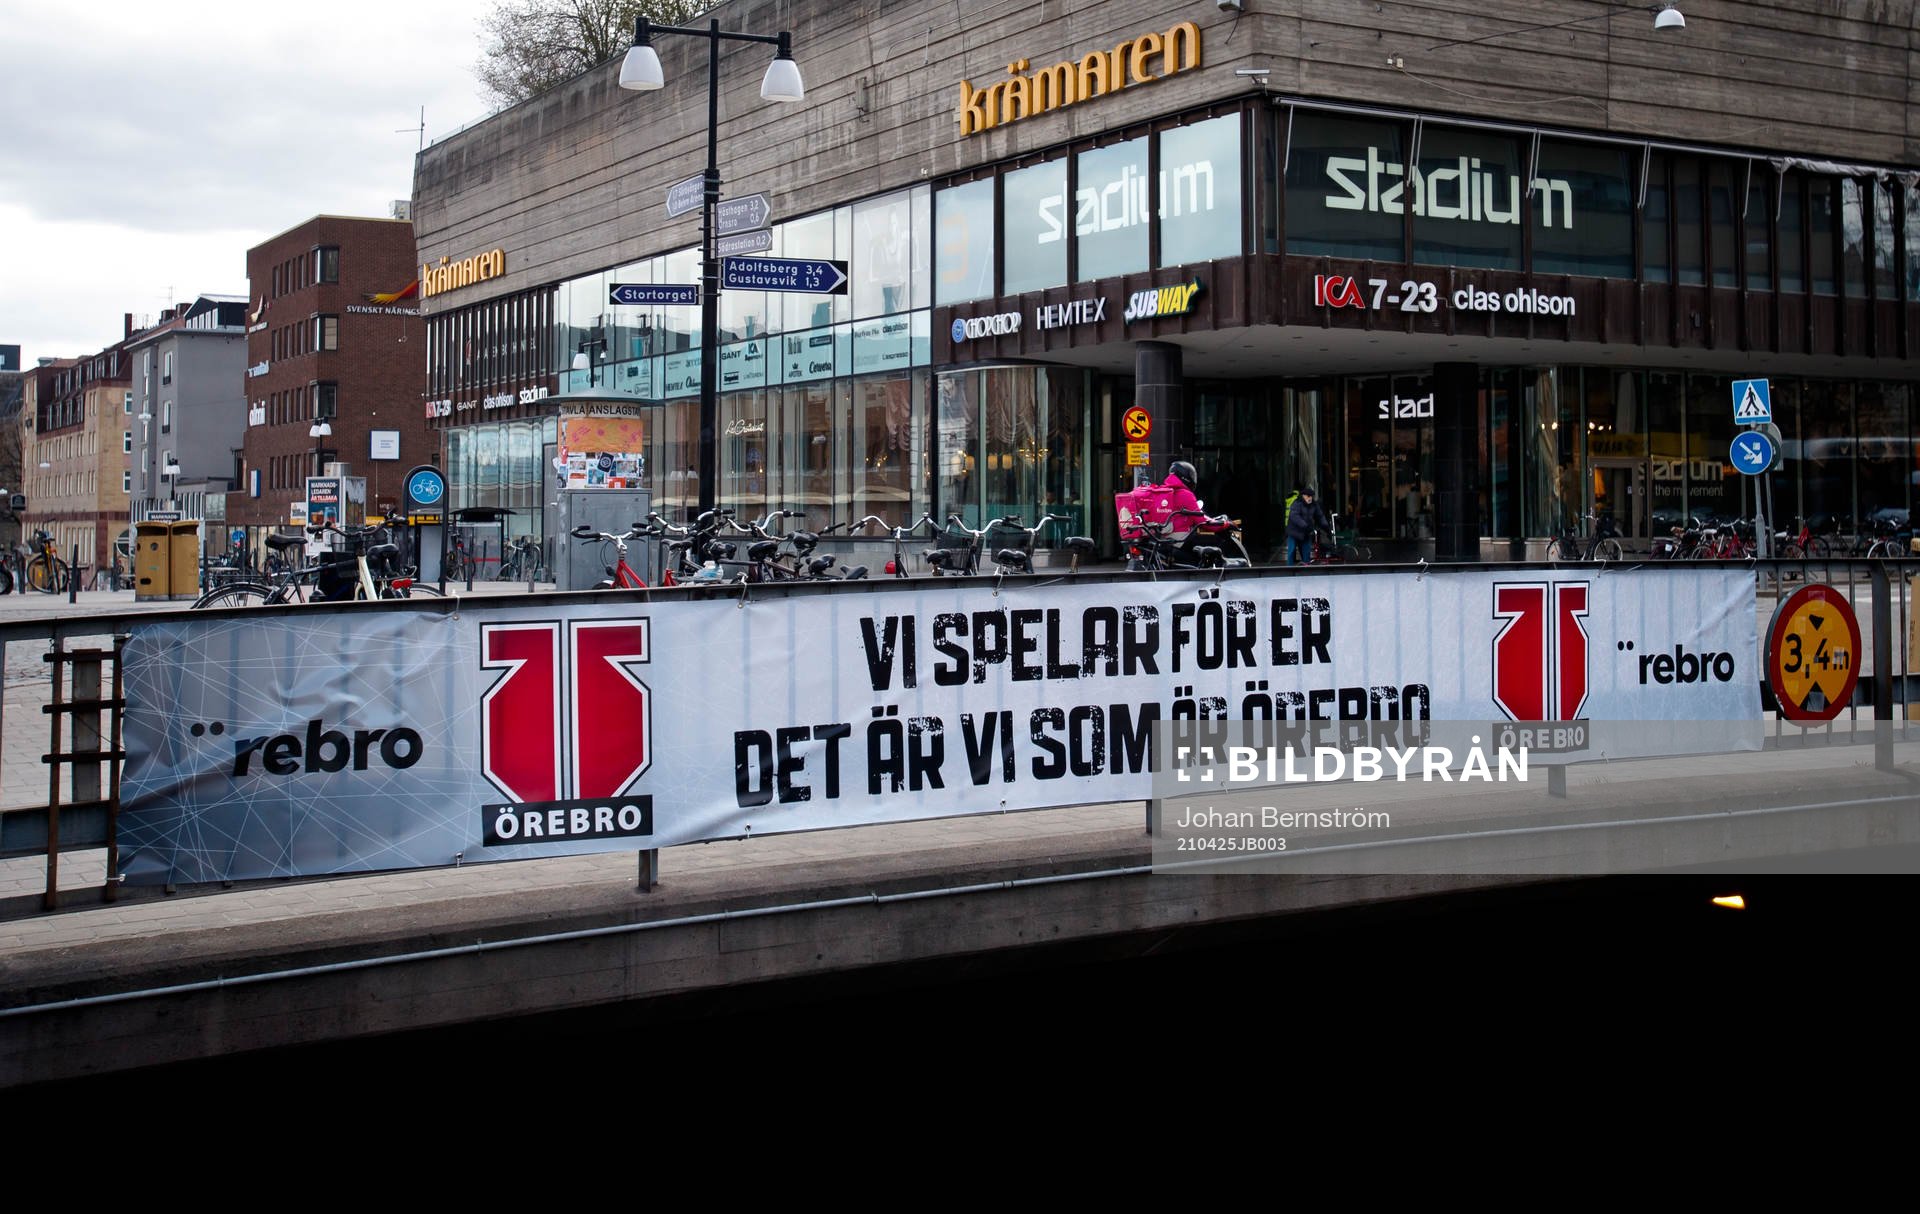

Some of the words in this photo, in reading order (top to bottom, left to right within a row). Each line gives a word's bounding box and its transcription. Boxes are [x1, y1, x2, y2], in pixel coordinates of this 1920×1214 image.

[959, 21, 1201, 136] krämaren
[1038, 160, 1214, 244] stadium
[1324, 147, 1573, 229] stadium
[422, 248, 504, 298] krämaren
[728, 273, 797, 287] Gustavsvik
[805, 277, 820, 288] 1,3
[729, 261, 798, 276] Adolfsberg
[805, 264, 823, 277] 3,4
[346, 305, 383, 314] SVENSKT
[623, 288, 693, 302] Stortorget
[1126, 282, 1199, 320] SUBWAY
[1315, 274, 1366, 309] ICA
[1368, 278, 1438, 313] 7-23
[1454, 284, 1501, 312] clas
[1504, 288, 1576, 316] ohlson
[1036, 297, 1107, 330] HEMTEX
[457, 400, 477, 411] GANT
[1378, 393, 1434, 419] stad
[859, 614, 917, 691] VI
[932, 604, 1160, 687] SPELAR
[1171, 588, 1257, 673] FÖR
[1271, 597, 1332, 666] ER
[734, 722, 852, 808] DET
[866, 704, 946, 796] ÄR
[959, 711, 1016, 786] VI
[1030, 702, 1161, 781] SOM
[1171, 685, 1229, 771] ÄR
[1241, 680, 1431, 761] ÖREBRO
[1500, 725, 1585, 749] ÖREBRO
[495, 804, 643, 840] ÖREBRO
